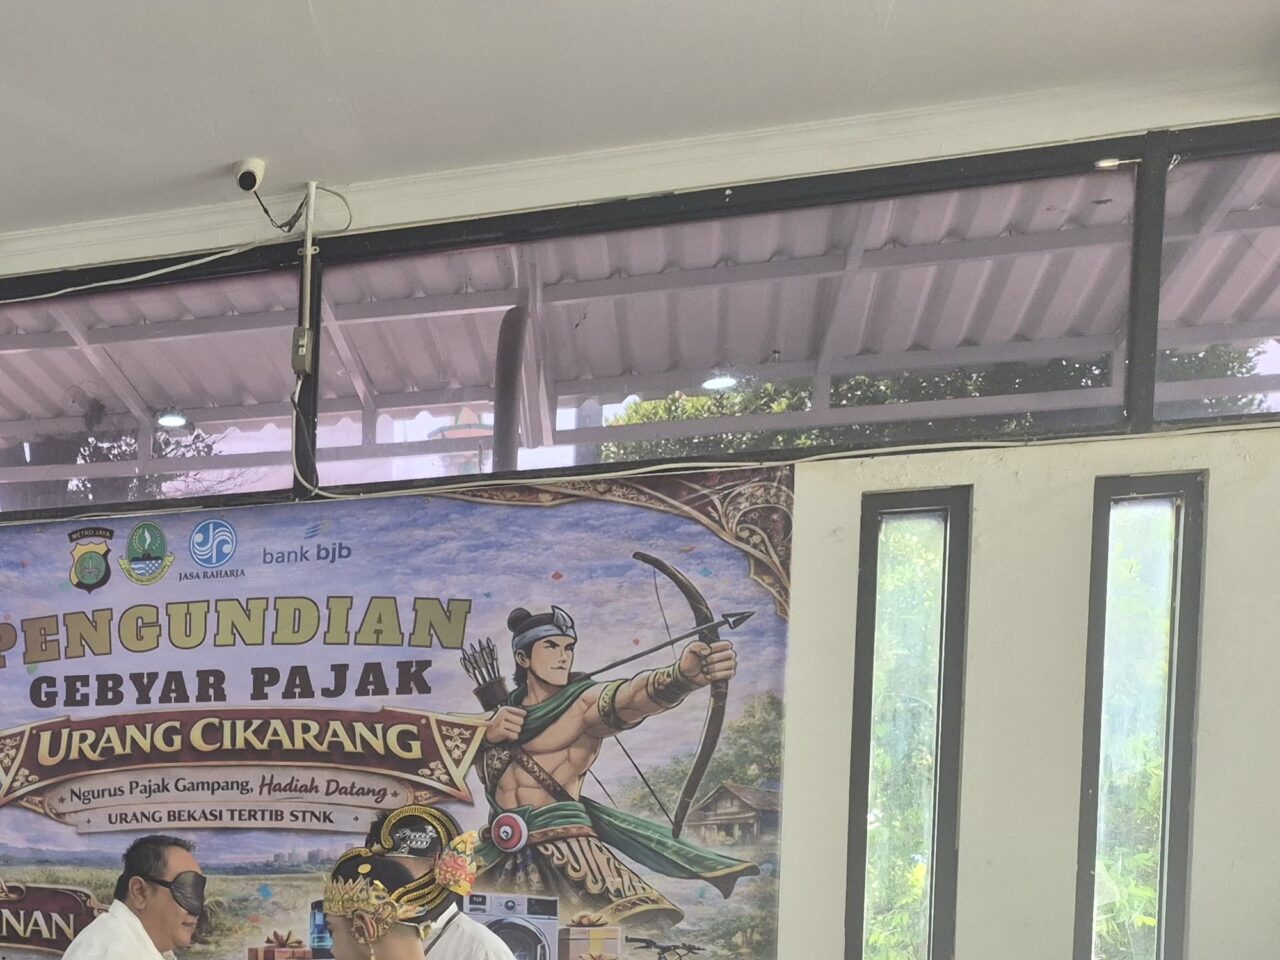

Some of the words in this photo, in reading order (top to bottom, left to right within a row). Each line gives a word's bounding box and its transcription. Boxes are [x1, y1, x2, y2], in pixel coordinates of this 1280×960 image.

[71, 530, 94, 539] METRO
[95, 530, 111, 538] JAYA
[262, 545, 311, 565] bank
[316, 542, 352, 564] bjb
[178, 571, 201, 582] JASA
[202, 568, 246, 580] RAHARJA
[29, 669, 227, 708] GEBYAR
[250, 659, 434, 700] PAJAK
[36, 719, 184, 767] URANG
[188, 716, 424, 760] CIKARANG
[69, 784, 125, 805] Ngurus
[128, 777, 171, 798] Pajak
[174, 777, 254, 795] Gampang,
[258, 774, 320, 796] Hadiah
[324, 778, 388, 804] Datang
[107, 810, 163, 825] URANG
[167, 809, 223, 823] BEKASI
[226, 808, 284, 822] TERTIB
[289, 809, 335, 824] STNK
